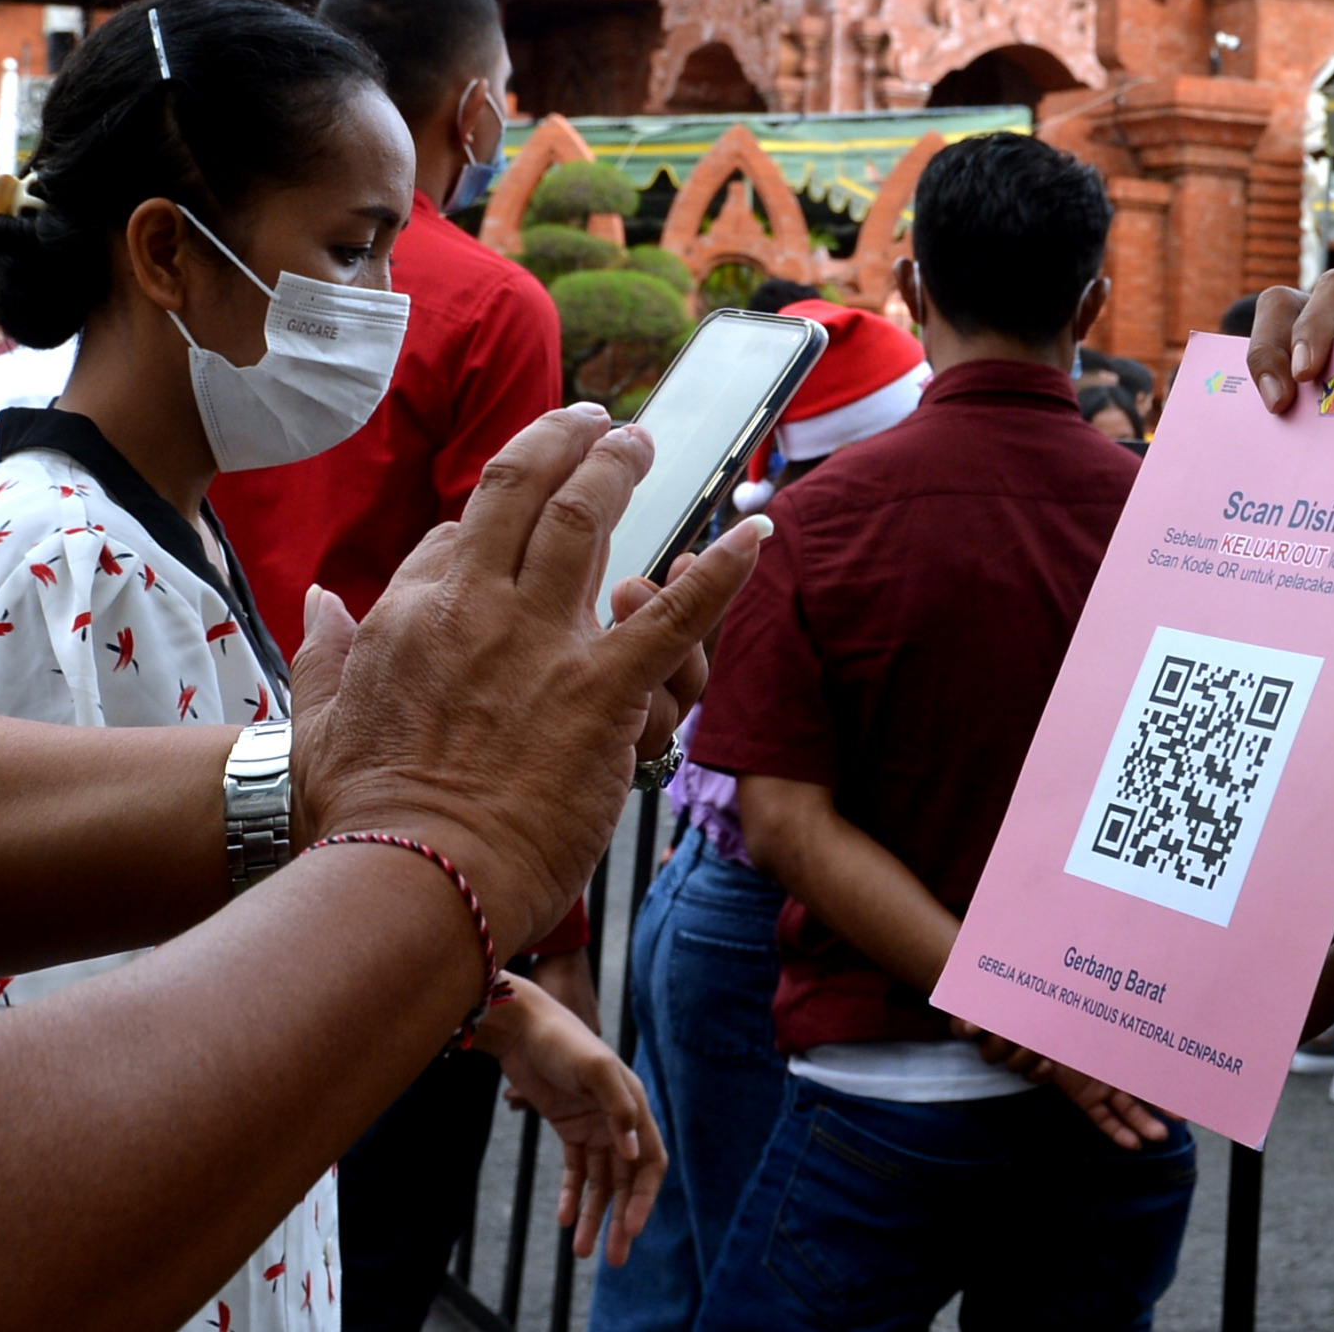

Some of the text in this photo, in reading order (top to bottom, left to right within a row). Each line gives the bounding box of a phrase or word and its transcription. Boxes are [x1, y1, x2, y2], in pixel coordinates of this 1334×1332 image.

[1223, 491, 1284, 526] Scan
[1164, 527, 1218, 551] Sebelum
[1219, 534, 1330, 567] KELUAR/OUT
[1148, 549, 1179, 568] Scan
[1181, 554, 1214, 574] Kode
[1216, 561, 1240, 579] QR
[1240, 567, 1275, 586] untuk
[1063, 946, 1167, 1004] Gerbang Barat
[978, 954, 1243, 1076] GEREJA KATOLIK ROH KUDUS KATEDRAL DENPASAR
